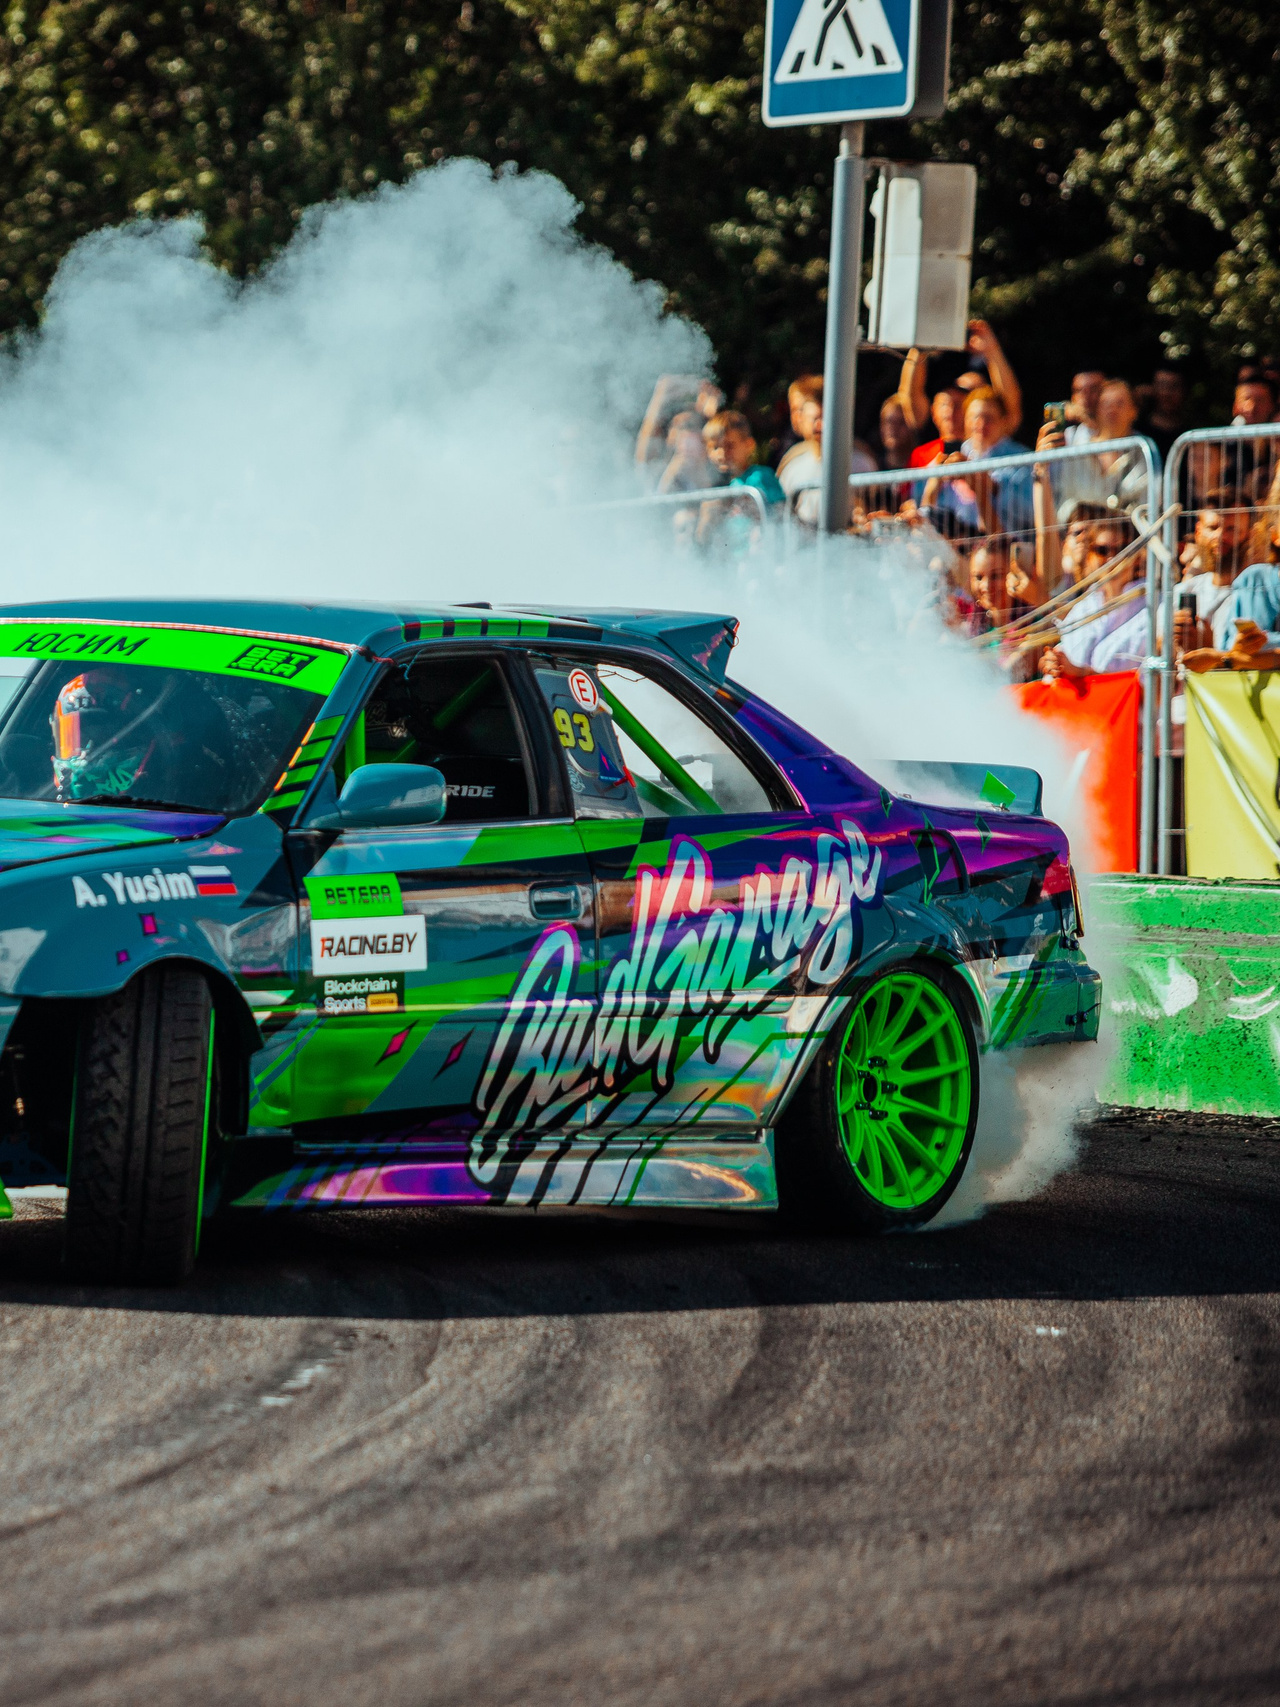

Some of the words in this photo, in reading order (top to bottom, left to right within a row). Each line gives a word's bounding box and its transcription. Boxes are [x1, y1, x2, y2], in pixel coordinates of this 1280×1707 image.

[12, 632, 150, 656] ЮСИМ
[246, 646, 310, 666] BET
[576, 678, 591, 703] E
[553, 707, 596, 753] 93
[72, 875, 108, 908] A.
[102, 867, 198, 905] Yusim
[320, 932, 418, 958] RACING.BY
[324, 977, 391, 995] Blockchain
[324, 996, 367, 1015] Sports
